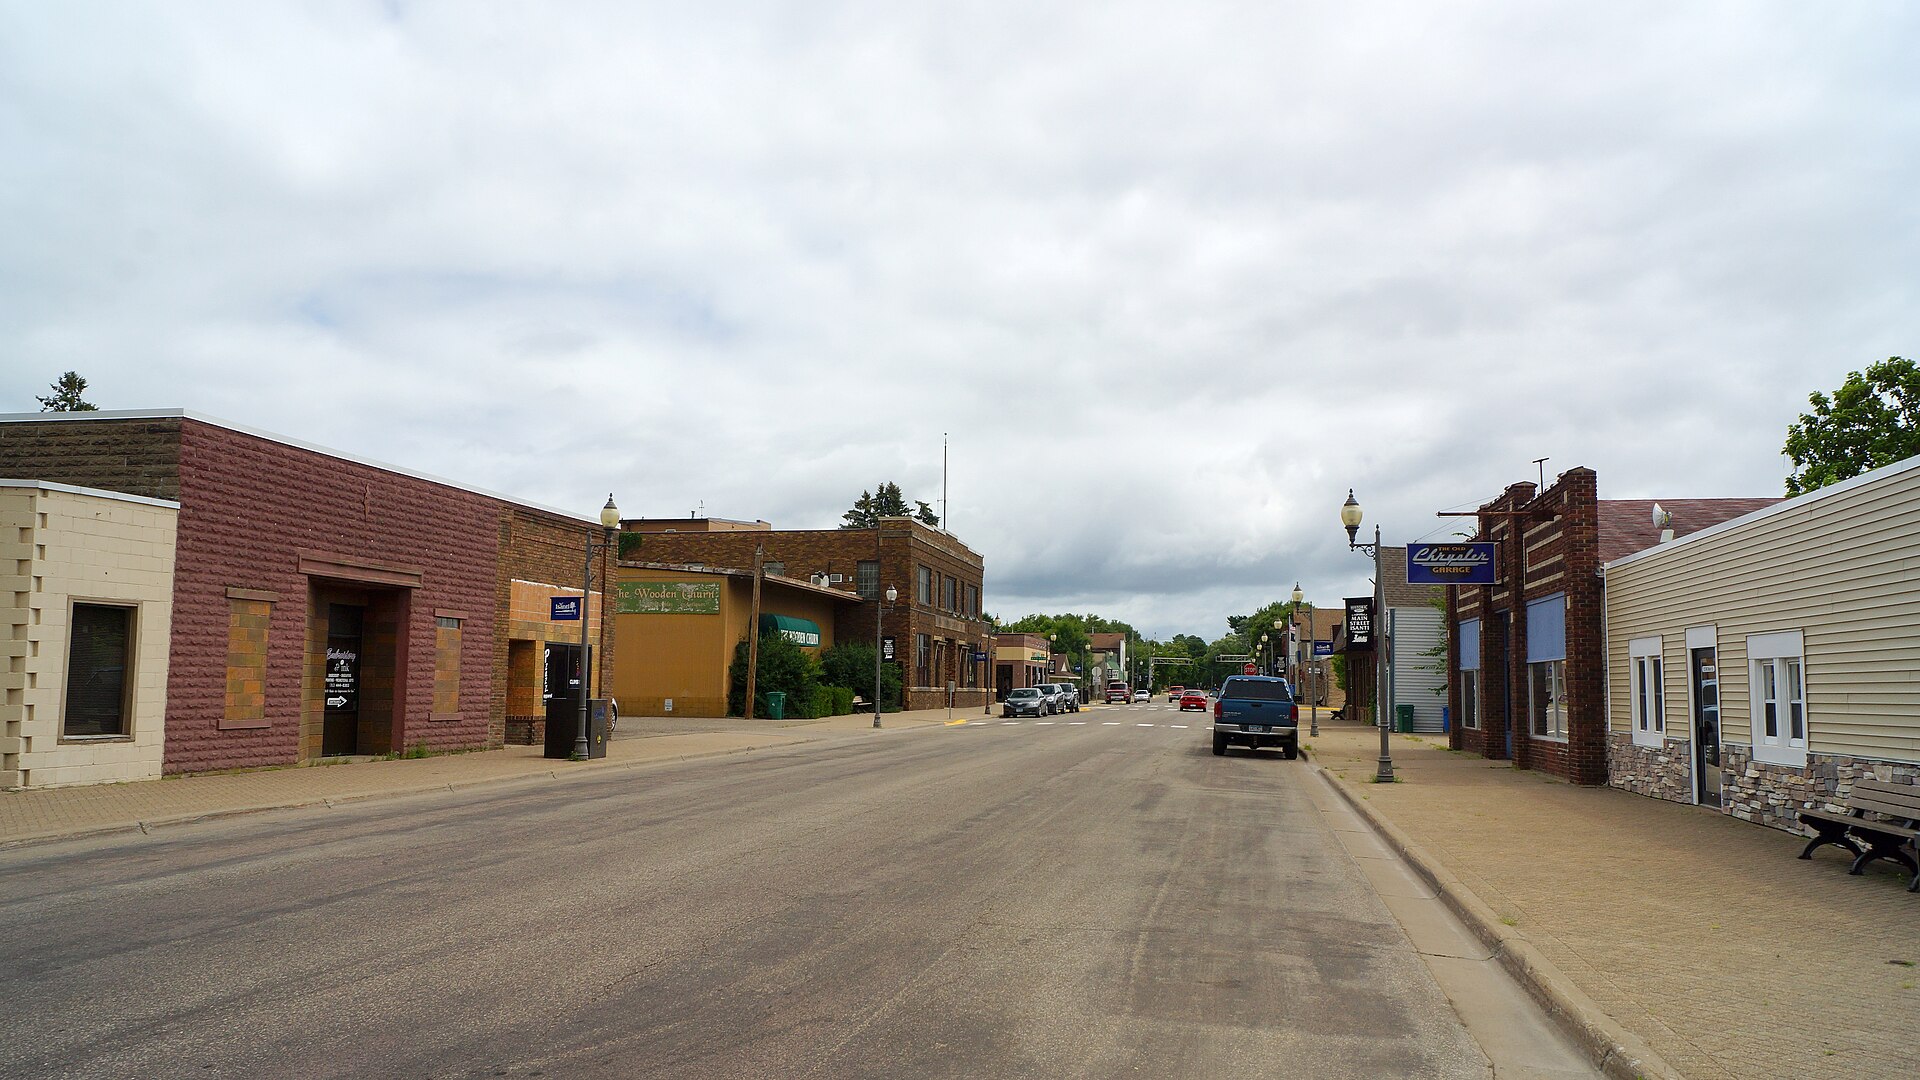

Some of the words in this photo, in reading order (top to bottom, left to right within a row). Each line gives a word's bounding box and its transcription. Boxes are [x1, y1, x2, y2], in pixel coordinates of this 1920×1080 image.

[1412, 547, 1490, 566] Chrysler
[634, 588, 677, 599] Wooden
[681, 589, 715, 599] Churn
